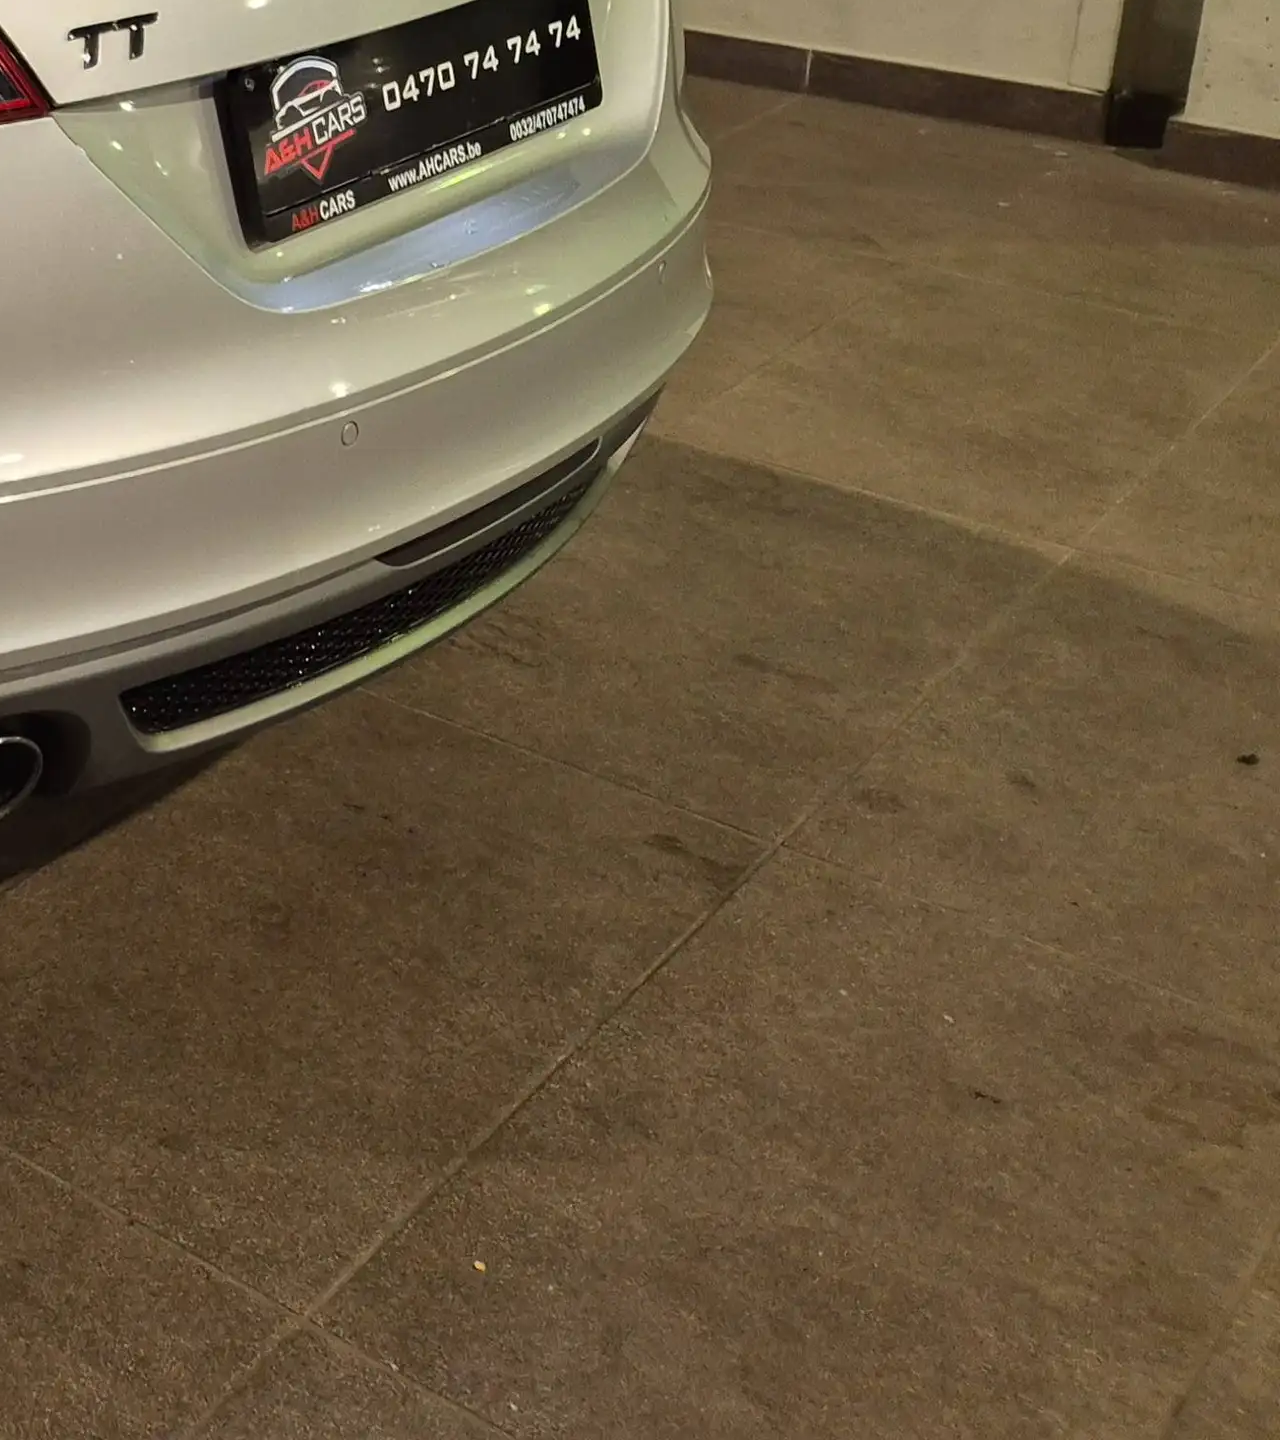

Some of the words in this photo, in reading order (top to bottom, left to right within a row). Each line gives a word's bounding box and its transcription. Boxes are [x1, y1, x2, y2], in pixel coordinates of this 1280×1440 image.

[67, 11, 160, 70] TT
[381, 61, 456, 112] 0470
[463, 45, 500, 80] 74
[506, 30, 541, 65] 74
[548, 14, 582, 49] 74
[264, 128, 314, 177] A&H
[312, 94, 367, 143] CARS
[388, 140, 482, 193] www.AHCARS.be
[508, 94, 587, 142] 0032/470747474
